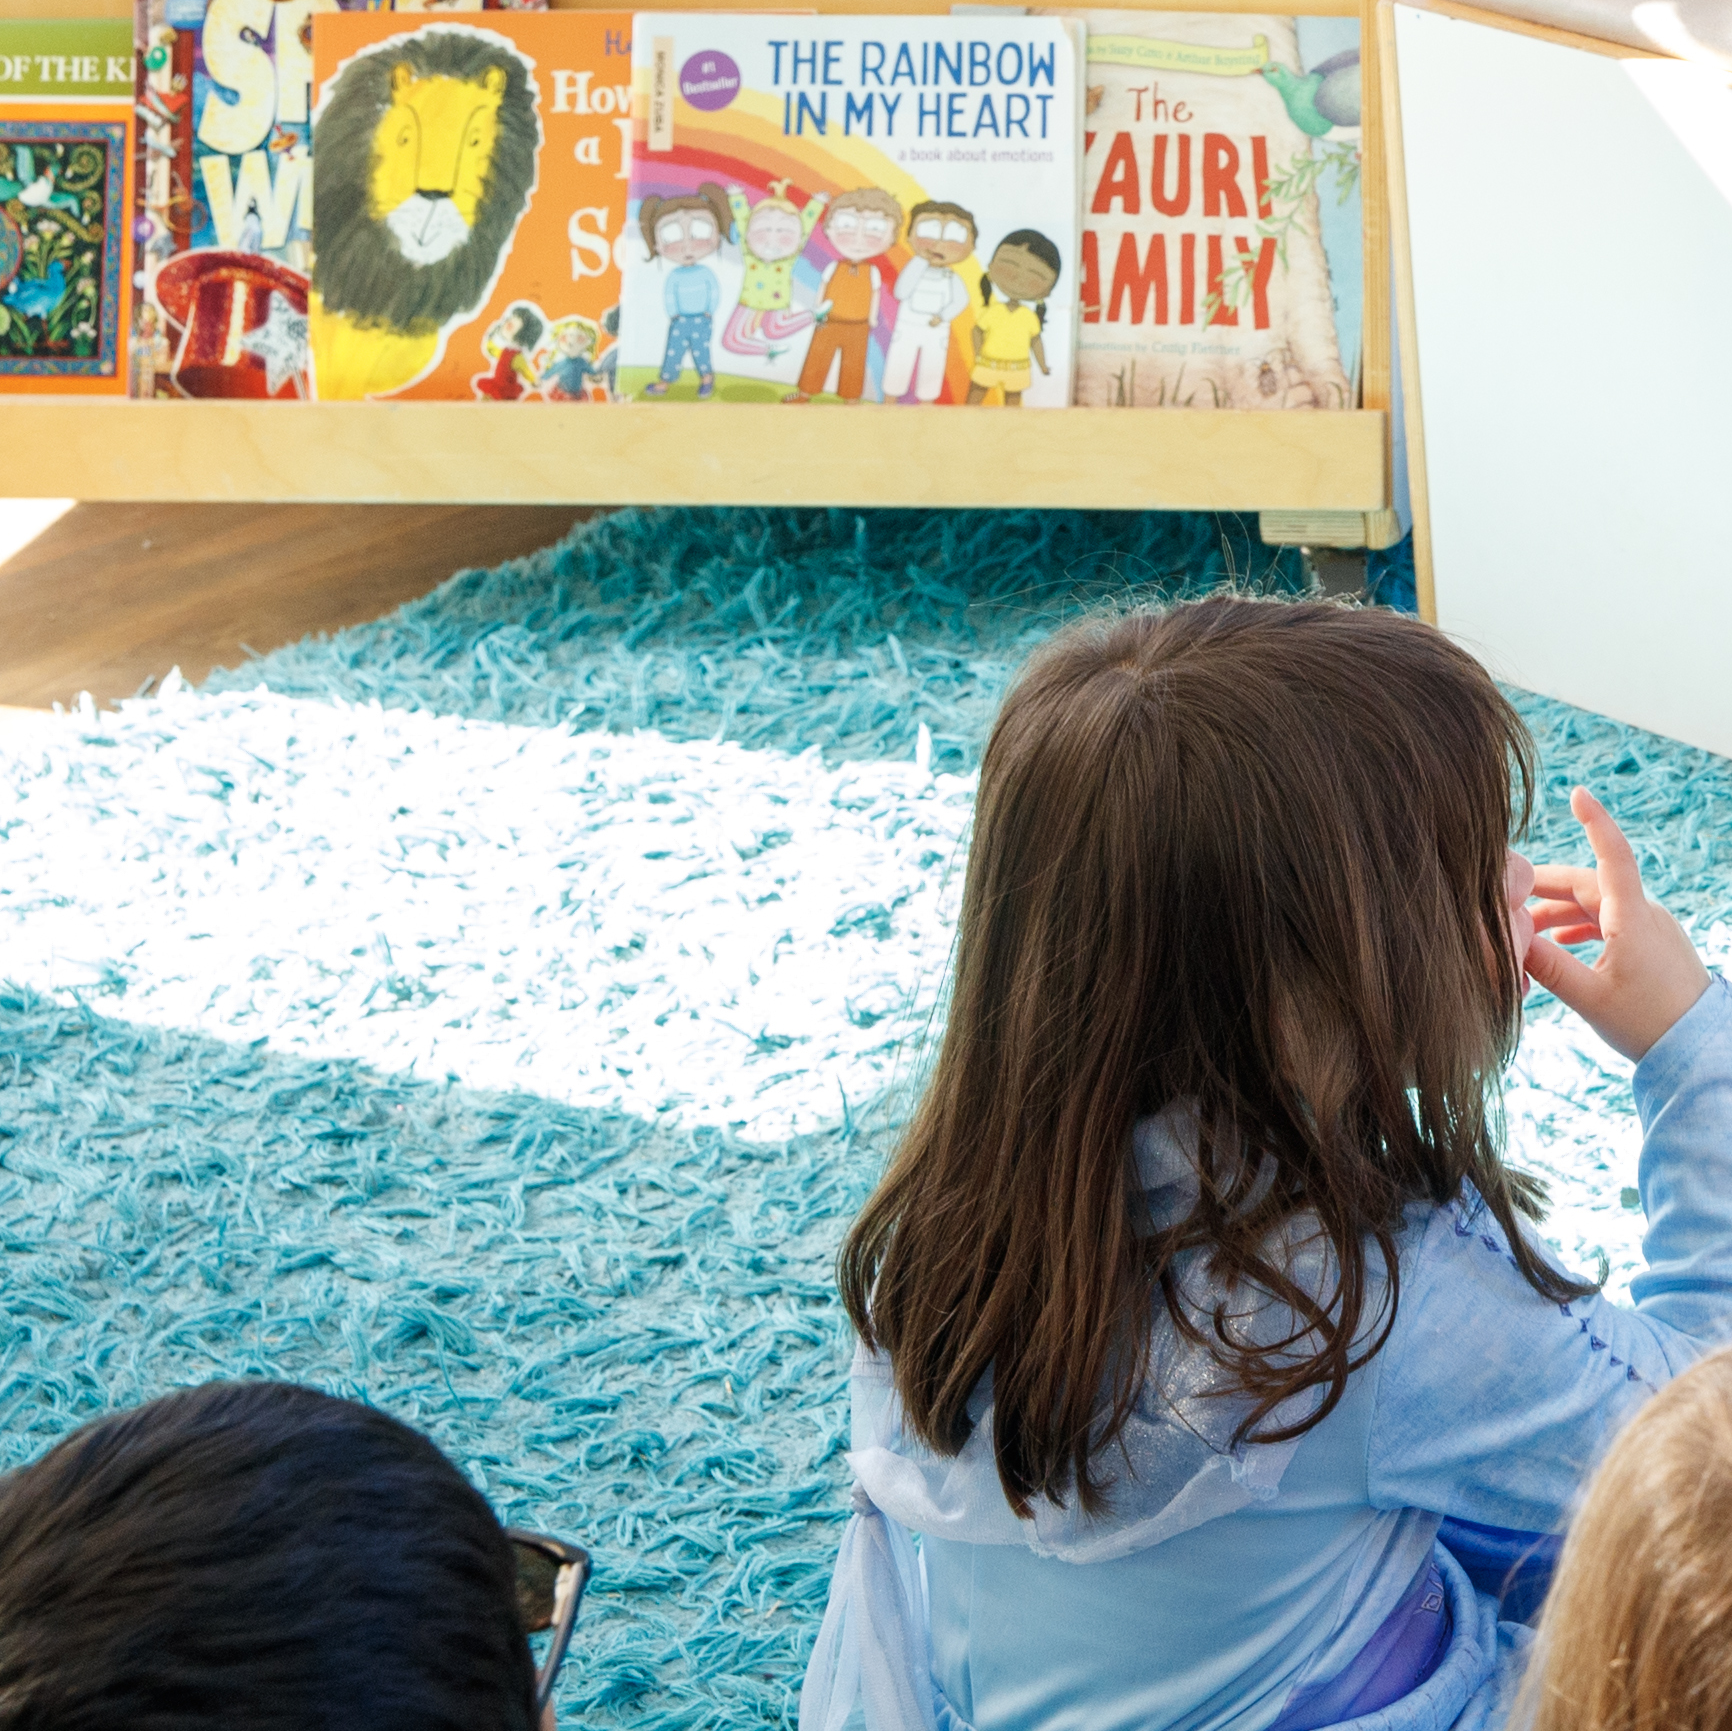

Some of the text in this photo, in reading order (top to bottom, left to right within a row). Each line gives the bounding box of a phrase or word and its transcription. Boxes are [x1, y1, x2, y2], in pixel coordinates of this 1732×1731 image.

[34, 55, 102, 83] THE
[767, 40, 1056, 88] THE RAINBOW
[783, 90, 1056, 139] IN MY HEART
[1125, 81, 1194, 123] The
